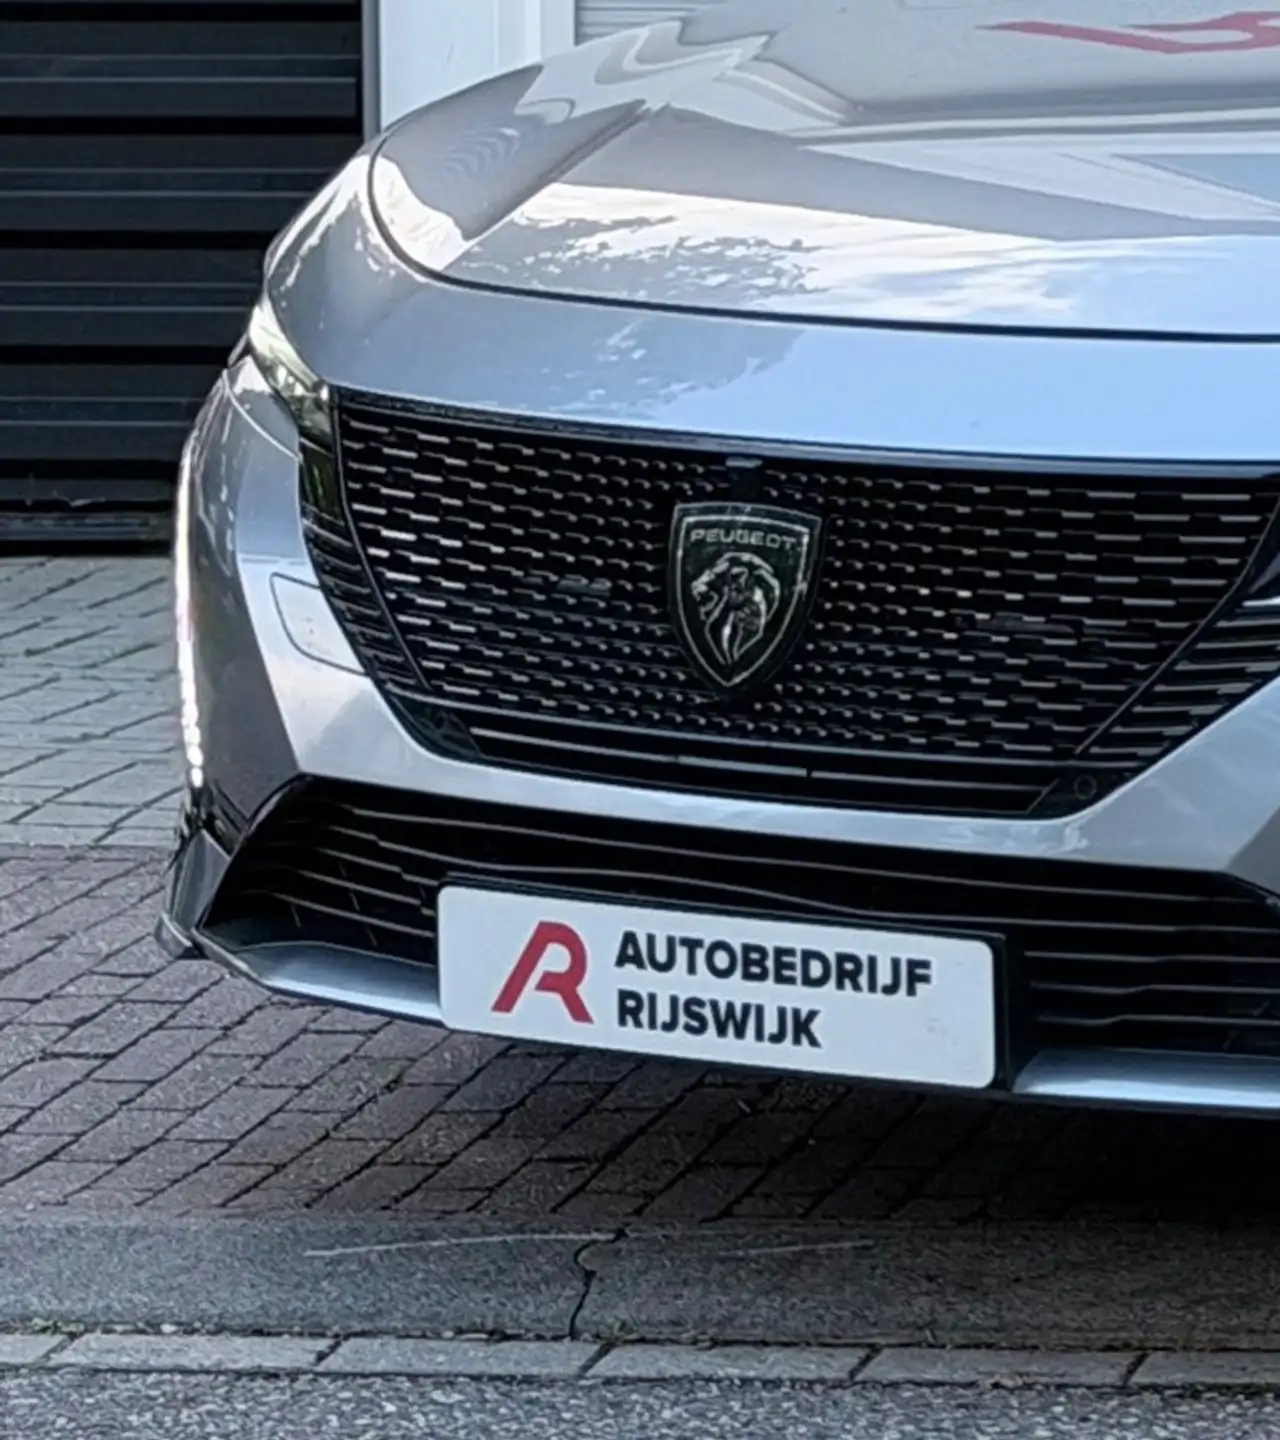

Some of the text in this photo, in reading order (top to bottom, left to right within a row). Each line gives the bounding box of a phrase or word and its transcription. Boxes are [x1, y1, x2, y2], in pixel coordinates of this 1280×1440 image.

[690, 527, 797, 550] PEUGEOT
[614, 930, 932, 997] AUTOBEDRIJF
[617, 988, 822, 1049] RIJSWIJK
